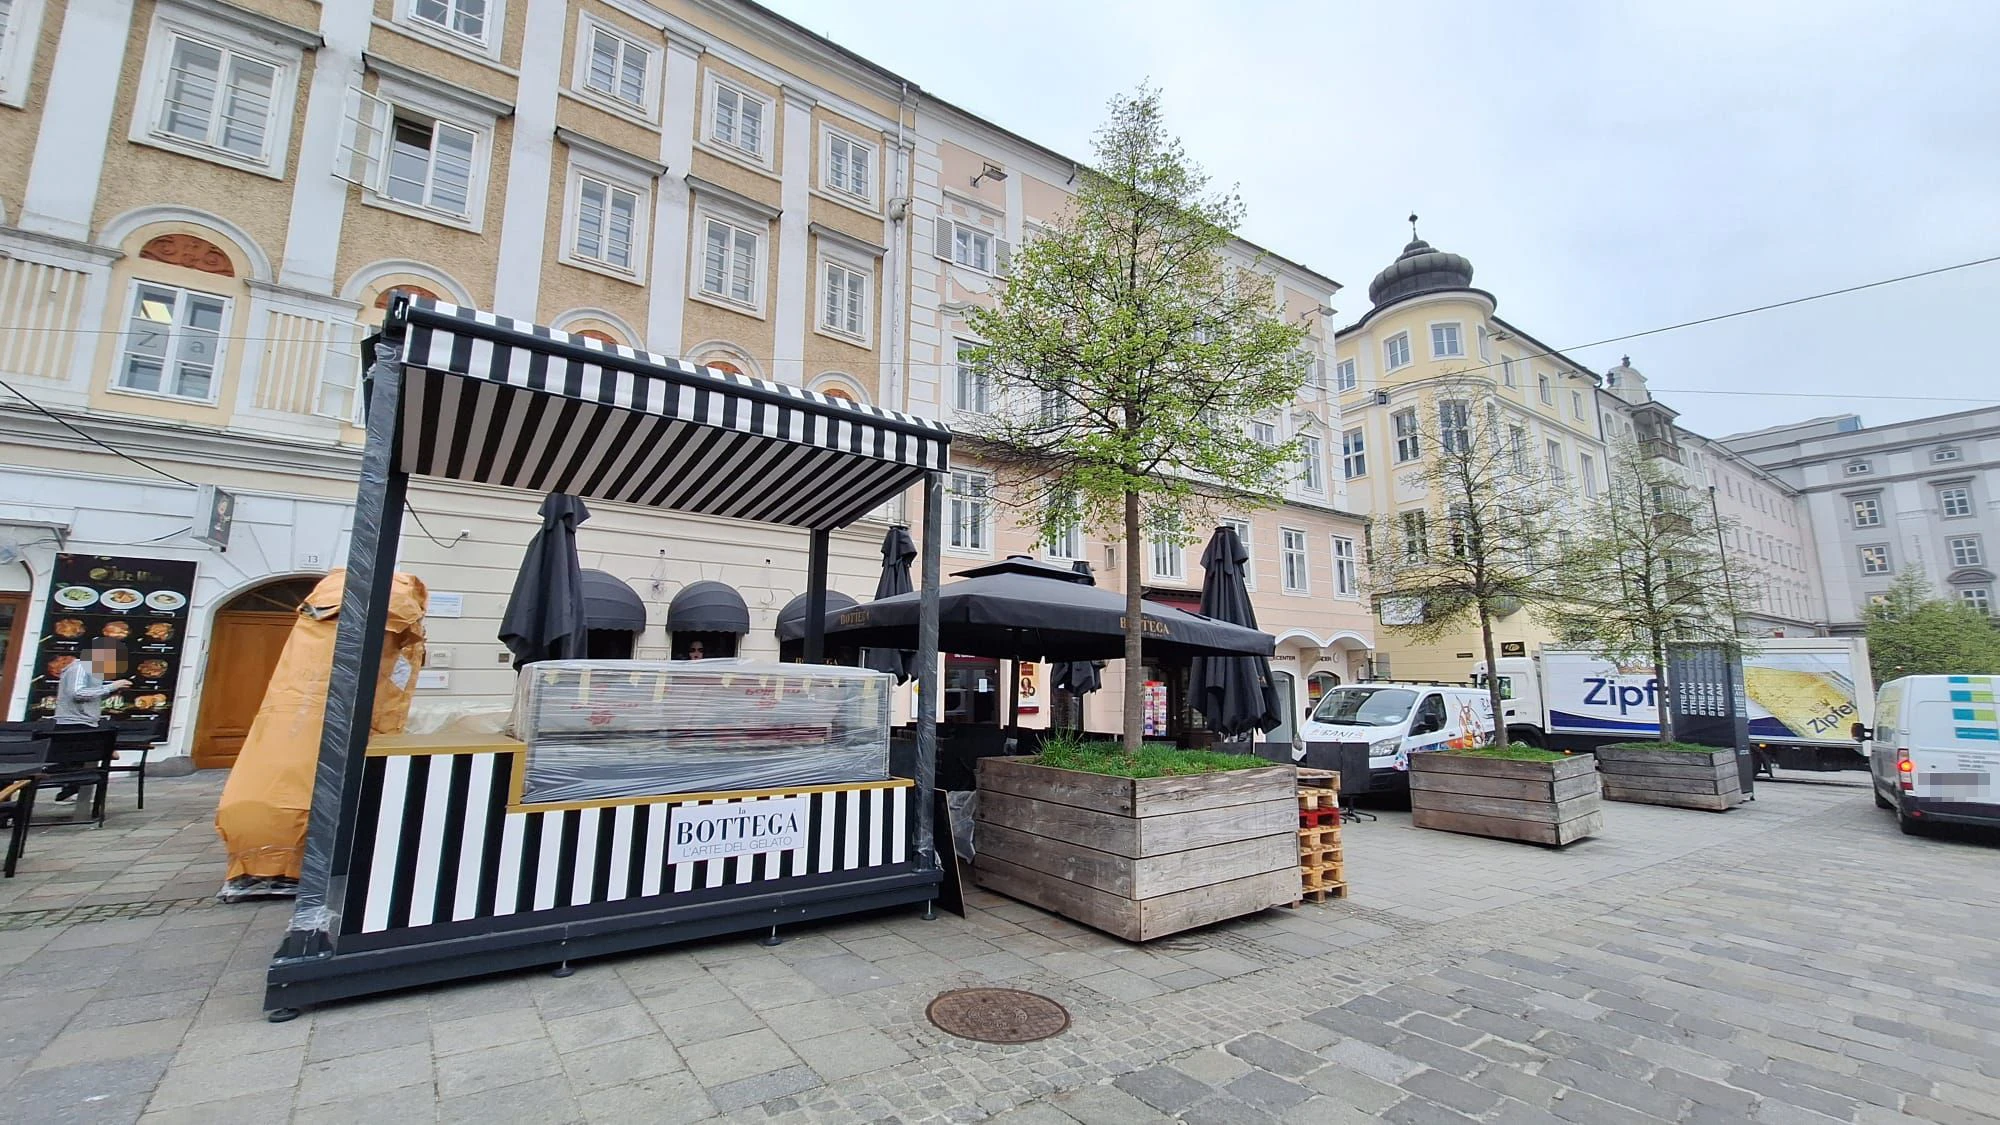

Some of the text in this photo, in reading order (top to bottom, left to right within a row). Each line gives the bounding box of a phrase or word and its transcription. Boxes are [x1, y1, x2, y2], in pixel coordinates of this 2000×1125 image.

[308, 555, 318, 563] 13
[1120, 616, 1170, 635] BTEGA
[1583, 678, 1669, 715] Zipf
[1680, 682, 1688, 715] STREAM
[1688, 682, 1697, 715] STREAM
[1698, 682, 1706, 716] STREAM
[1706, 683, 1716, 716] STREAM
[1716, 683, 1725, 717] STREAM
[677, 812, 798, 845] BOTTEGA
[683, 837, 792, 857] L'ARTE DEL GELATO
